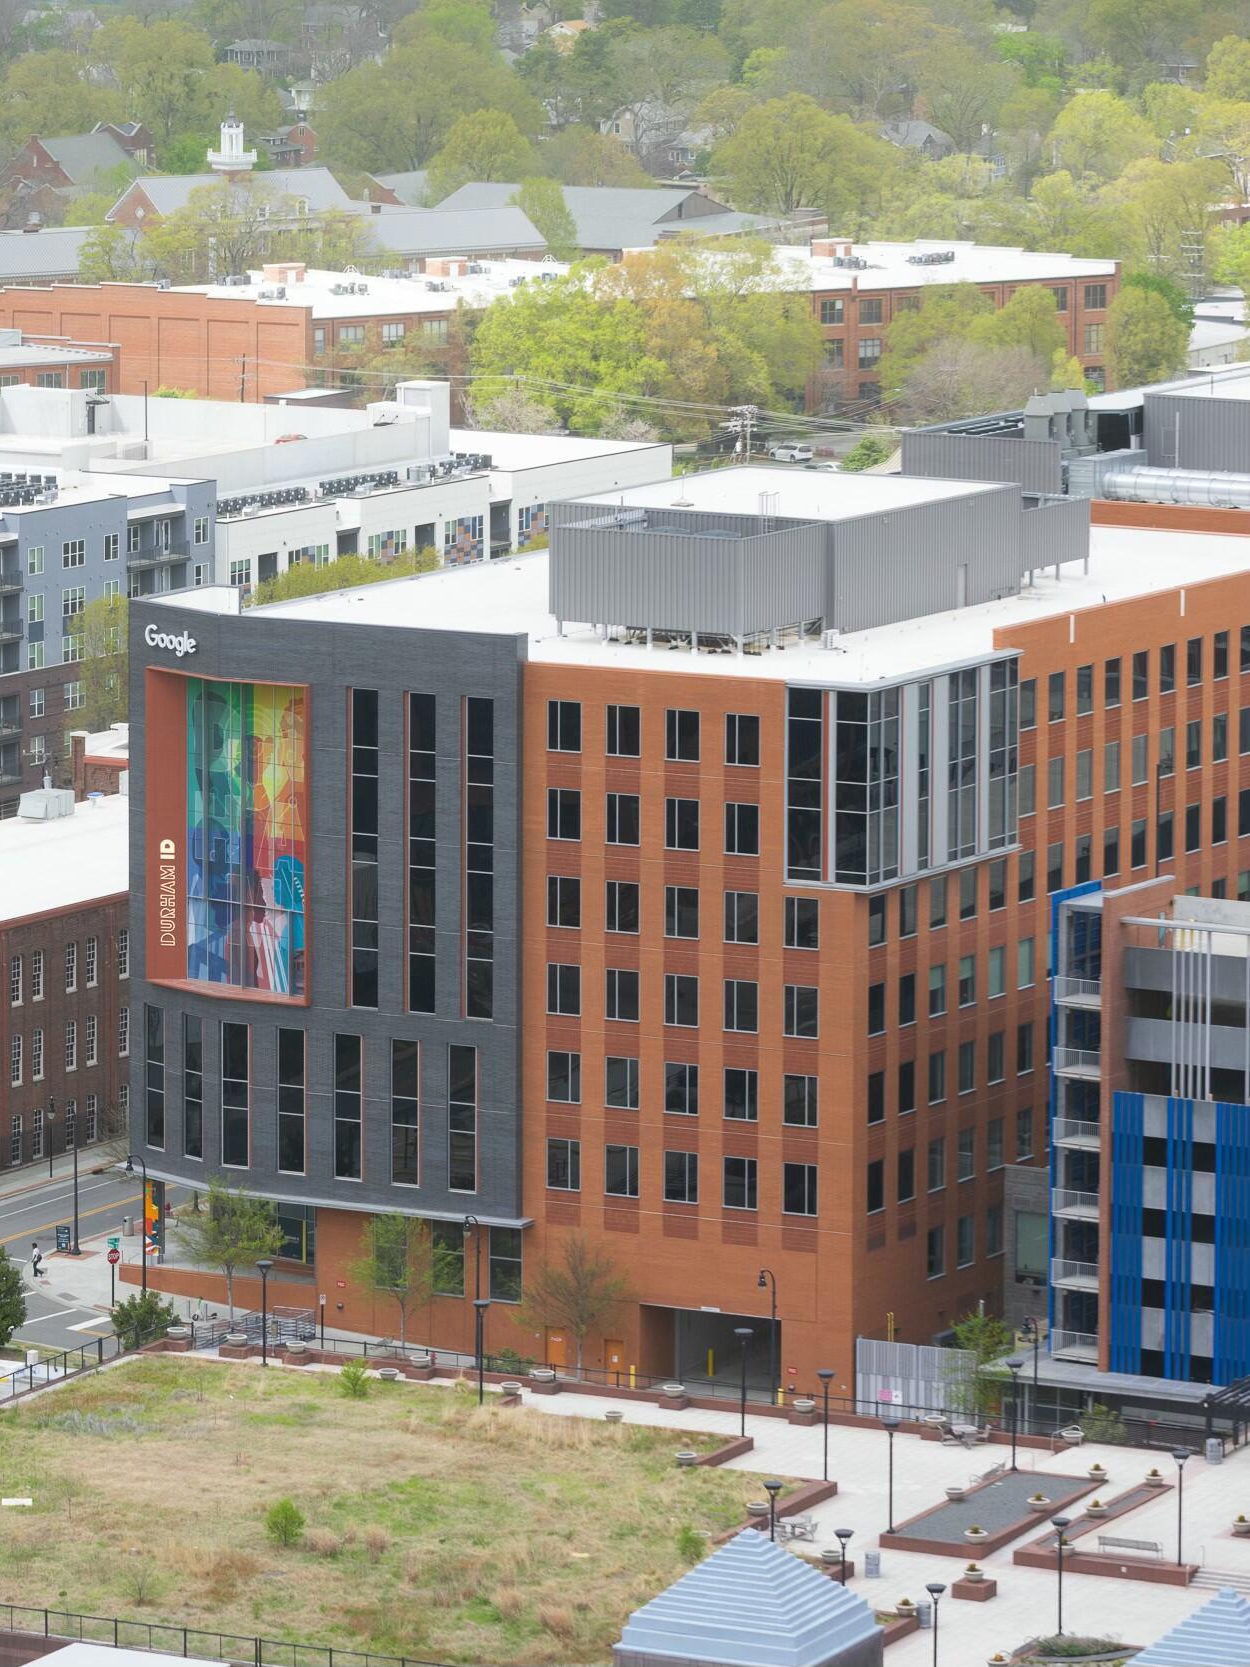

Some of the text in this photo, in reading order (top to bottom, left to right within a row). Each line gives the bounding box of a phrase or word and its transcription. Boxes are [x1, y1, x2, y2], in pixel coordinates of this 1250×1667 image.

[145, 624, 196, 657] Google
[160, 839, 175, 946] DURHAM ID
[108, 1252, 119, 1260] STOP
